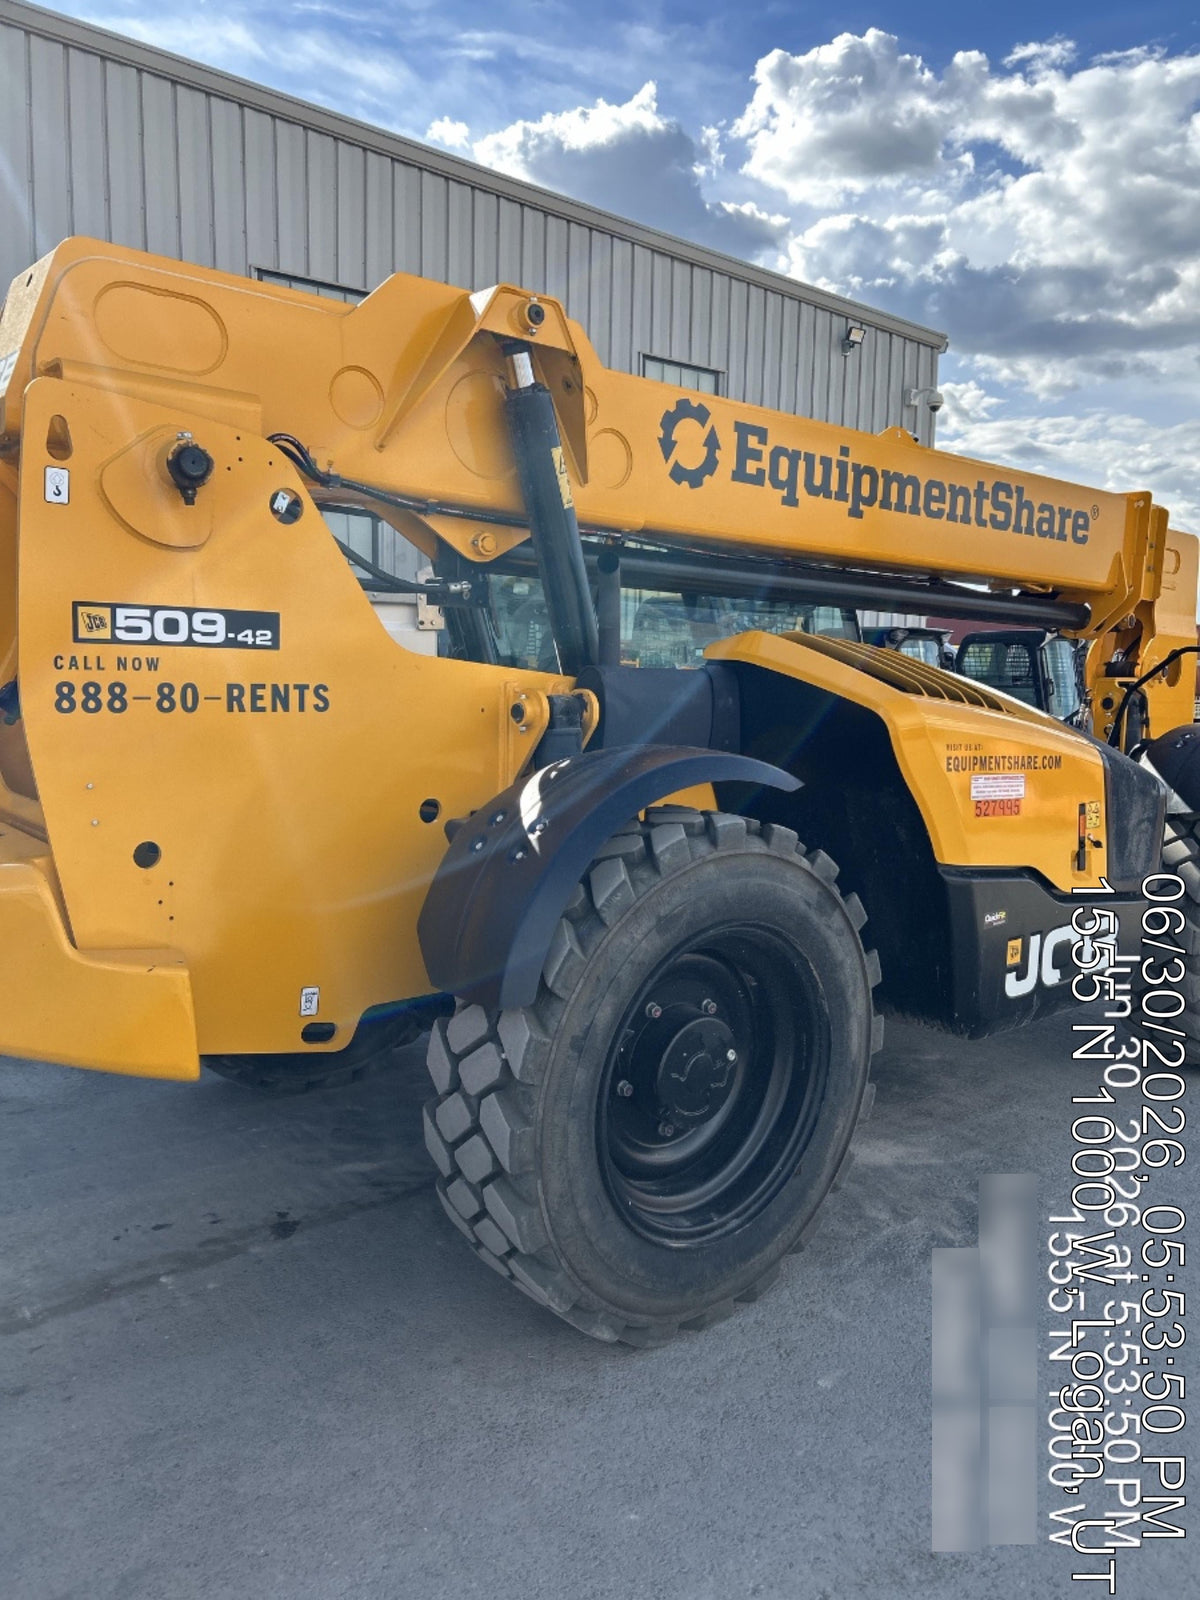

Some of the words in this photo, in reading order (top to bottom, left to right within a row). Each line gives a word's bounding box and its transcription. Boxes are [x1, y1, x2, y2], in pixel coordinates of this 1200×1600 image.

[114, 606, 273, 647] 509-42
[53, 655, 106, 672] CALL
[116, 656, 160, 672] NOW
[54, 681, 331, 714] 888-80-RENTS
[946, 743, 963, 752] VISIT
[946, 755, 1062, 772] EQUIPMENTSHARE.COM
[975, 799, 1020, 817] 527995
